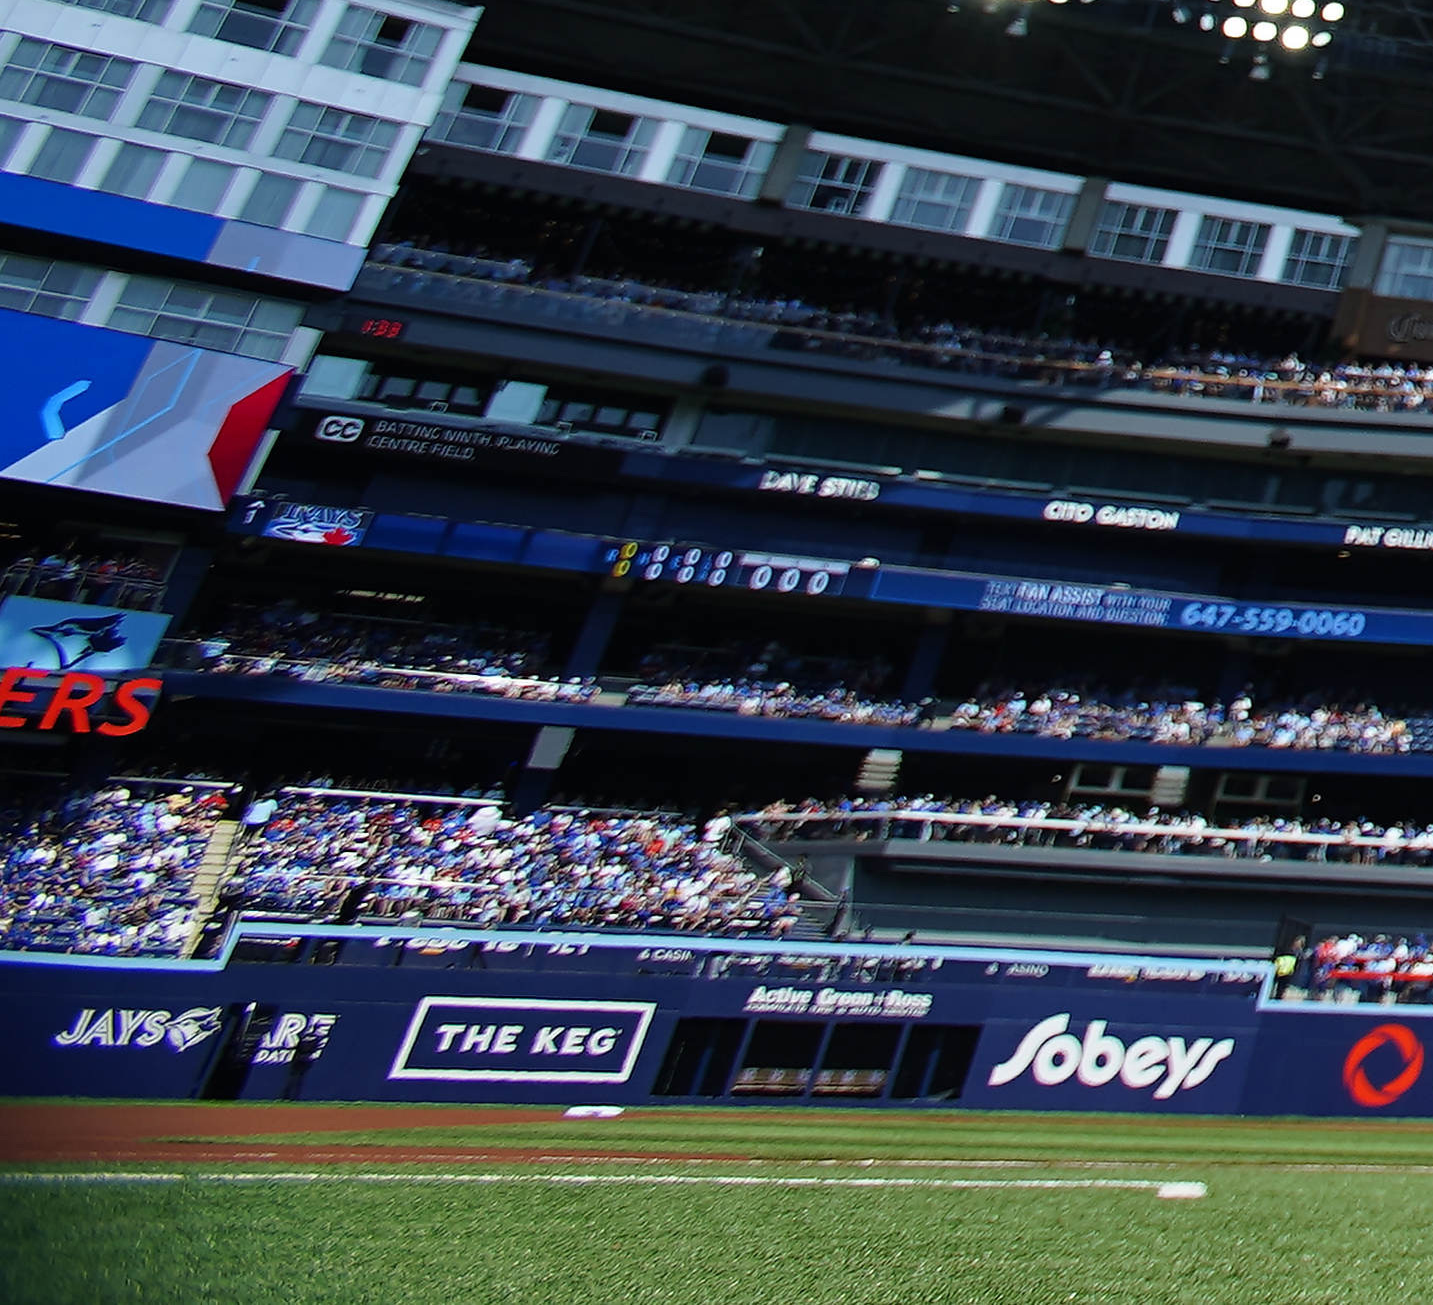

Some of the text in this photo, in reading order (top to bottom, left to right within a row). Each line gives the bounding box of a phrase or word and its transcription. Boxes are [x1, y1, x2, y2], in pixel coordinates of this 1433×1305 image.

[323, 418, 360, 439] CC
[367, 435, 427, 455] CENTRE
[758, 471, 818, 494] DAVE
[1043, 500, 1180, 530] CITO GASTON
[1344, 526, 1383, 547] PAT
[621, 541, 639, 559] 0
[653, 545, 671, 563] 0
[684, 548, 702, 566] 0
[715, 551, 733, 569] 0
[612, 559, 631, 578] 0
[645, 563, 663, 581] 0
[677, 565, 695, 584] 0
[708, 568, 726, 587] 0
[750, 565, 773, 589] 0
[776, 568, 800, 593] 0
[807, 570, 830, 595] 0
[1015, 598, 1075, 616] LOCATION
[1076, 604, 1104, 619] AND
[1050, 584, 1105, 605] ASSIST
[1138, 596, 1172, 611] YOUR
[1181, 603, 1366, 637] 647-559-0060
[747, 986, 813, 1005] Active
[54, 1008, 172, 1047] JAYS
[435, 1023, 617, 1056] THE KEG
[987, 1012, 1236, 1100] Sobeys
